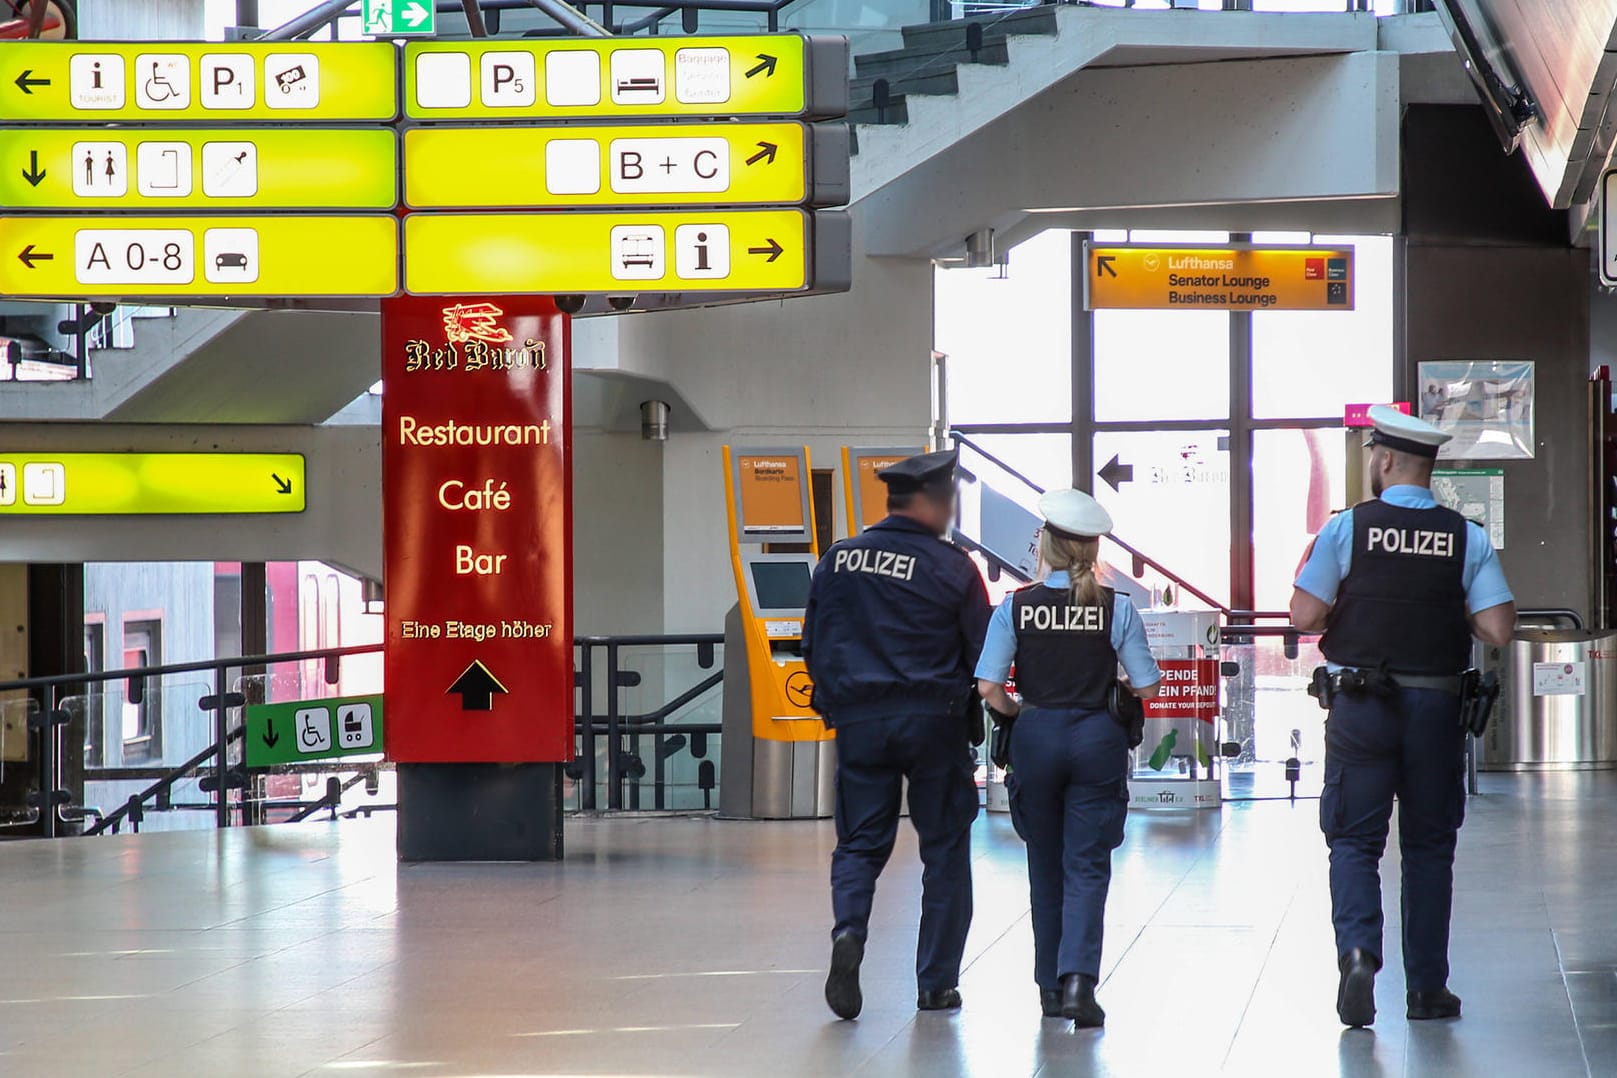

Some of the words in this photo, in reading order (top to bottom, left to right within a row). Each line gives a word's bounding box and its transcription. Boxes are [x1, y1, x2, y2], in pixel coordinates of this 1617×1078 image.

[620, 152, 644, 179] B
[693, 151, 718, 178] C
[86, 243, 111, 270] A
[126, 242, 182, 271] 0-8
[1168, 256, 1233, 270] Lufthansa
[1168, 274, 1220, 287] Senator
[1223, 274, 1270, 289] Lounge
[1168, 291, 1226, 304] Business
[1229, 291, 1277, 306] Lounge
[405, 339, 458, 371] Red
[464, 338, 547, 371] Baron
[400, 417, 551, 446] Restaurant
[753, 460, 787, 469] Lufthansa
[438, 479, 511, 510] Café
[1367, 527, 1454, 557] POLIZEI
[456, 545, 507, 575] Bar
[834, 549, 916, 581] POLIZEI
[402, 621, 441, 638] Eine
[445, 621, 496, 642] Etage
[500, 620, 552, 638] höher
[1020, 605, 1104, 631] POLIZEI
[1160, 669, 1199, 681] PENDE
[1158, 685, 1180, 697] EIN
[1182, 684, 1217, 697] PFAND!
[1149, 702, 1177, 710] DONATE
[1177, 702, 1195, 710] YOUR
